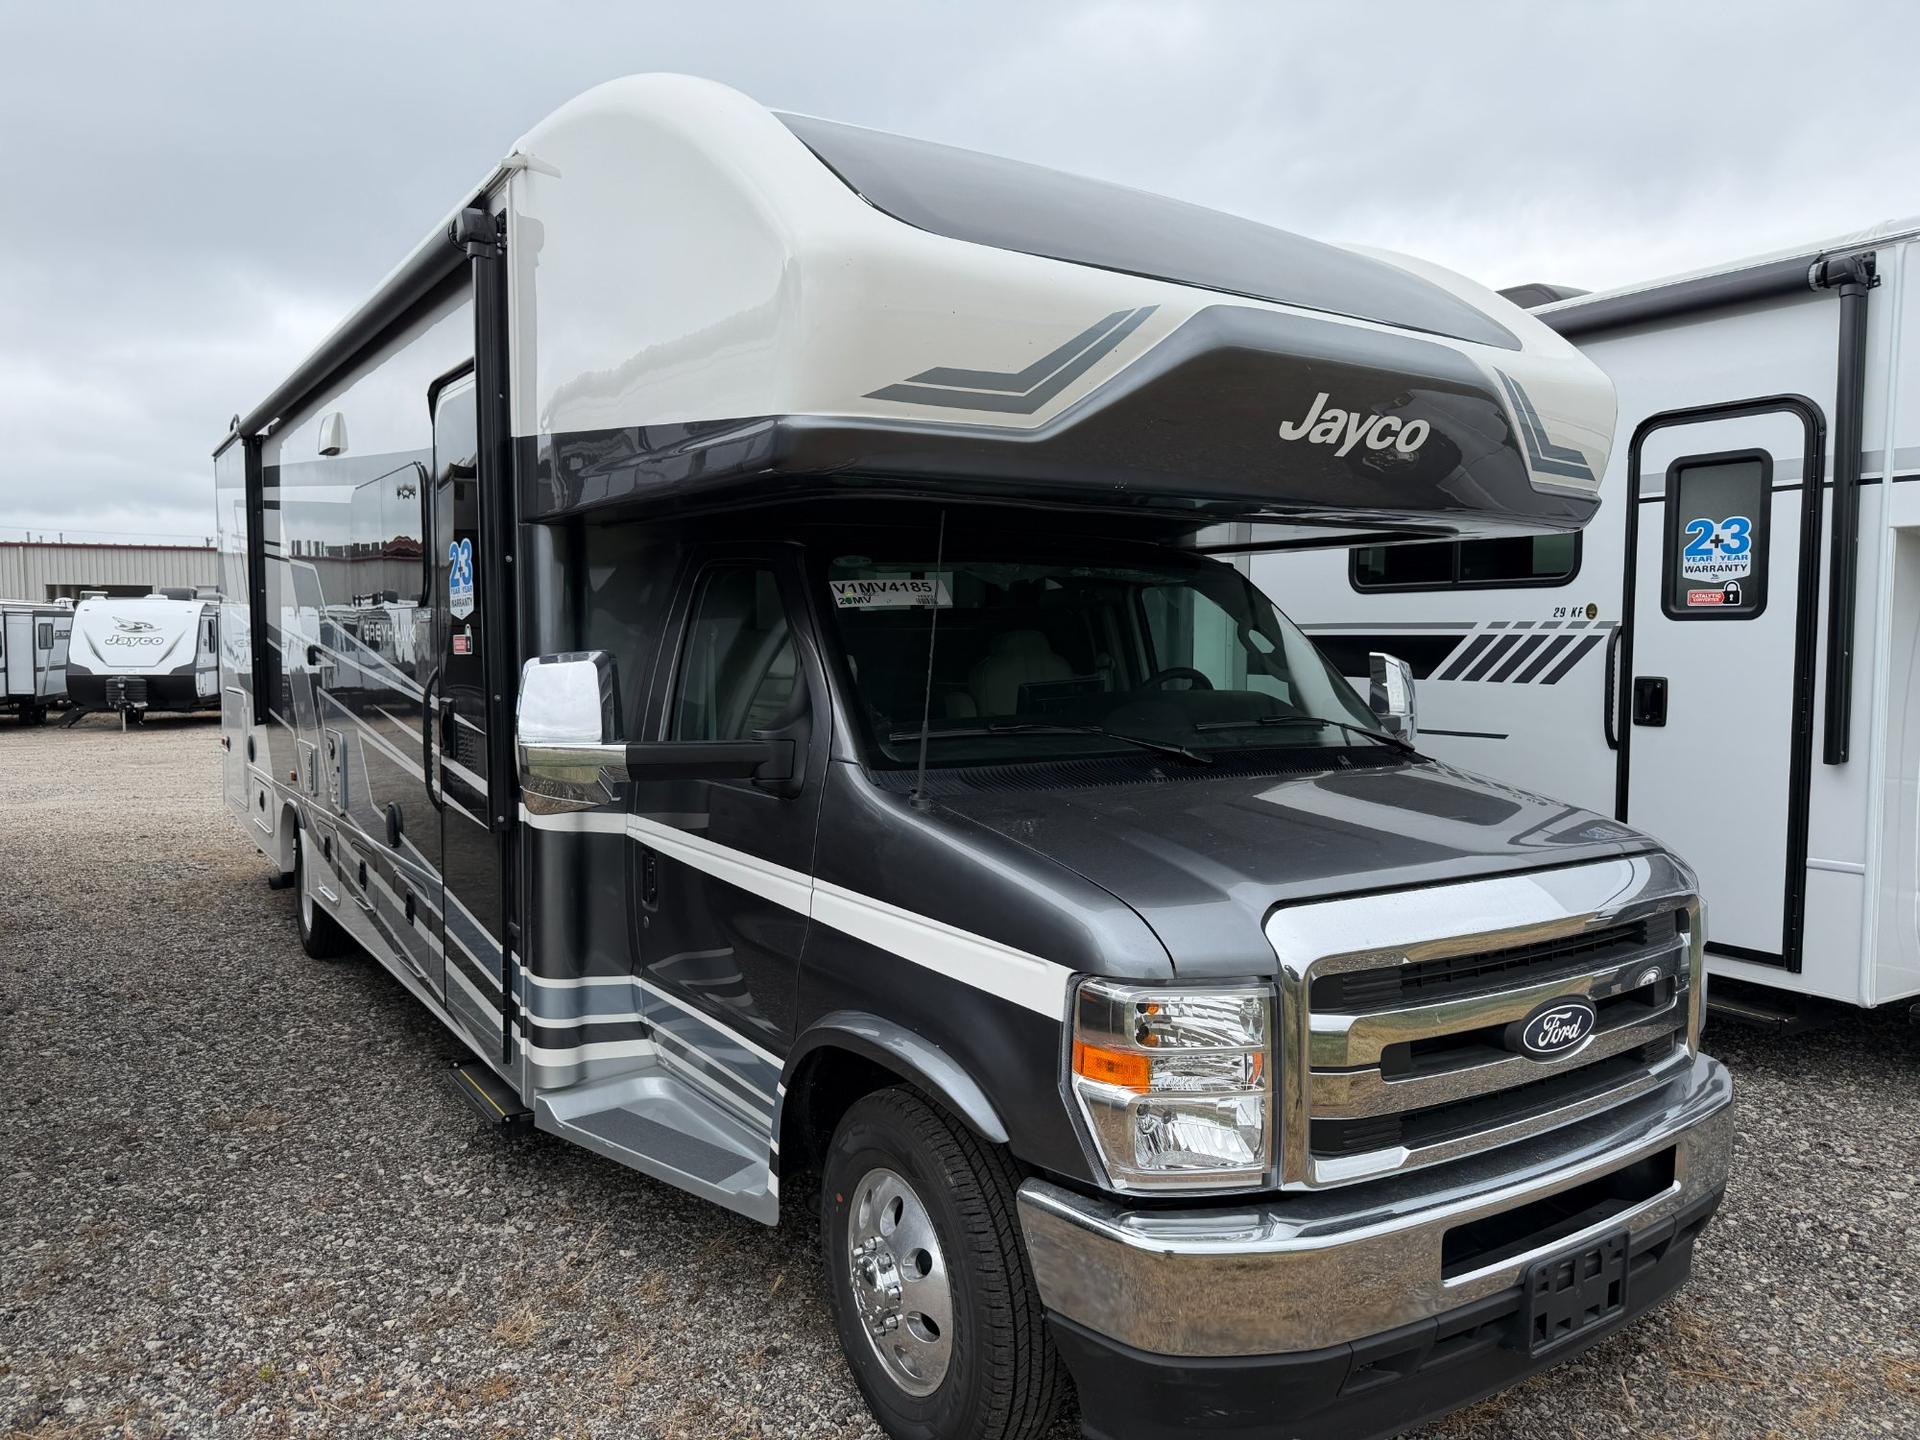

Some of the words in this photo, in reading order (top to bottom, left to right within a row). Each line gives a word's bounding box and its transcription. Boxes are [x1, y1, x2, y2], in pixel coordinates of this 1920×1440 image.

[1279, 392, 1431, 457] Jayco
[1684, 564, 1748, 573] WARRANTY
[833, 582, 932, 594] V1MV4185
[451, 597, 473, 608] WARRANTY
[838, 596, 872, 605] 2MV
[1553, 606, 1567, 618] 29
[1570, 606, 1584, 618] KF
[363, 624, 417, 643] GREYHAWK
[105, 634, 164, 647] Jayco
[1538, 1011, 1582, 1047] Ford
